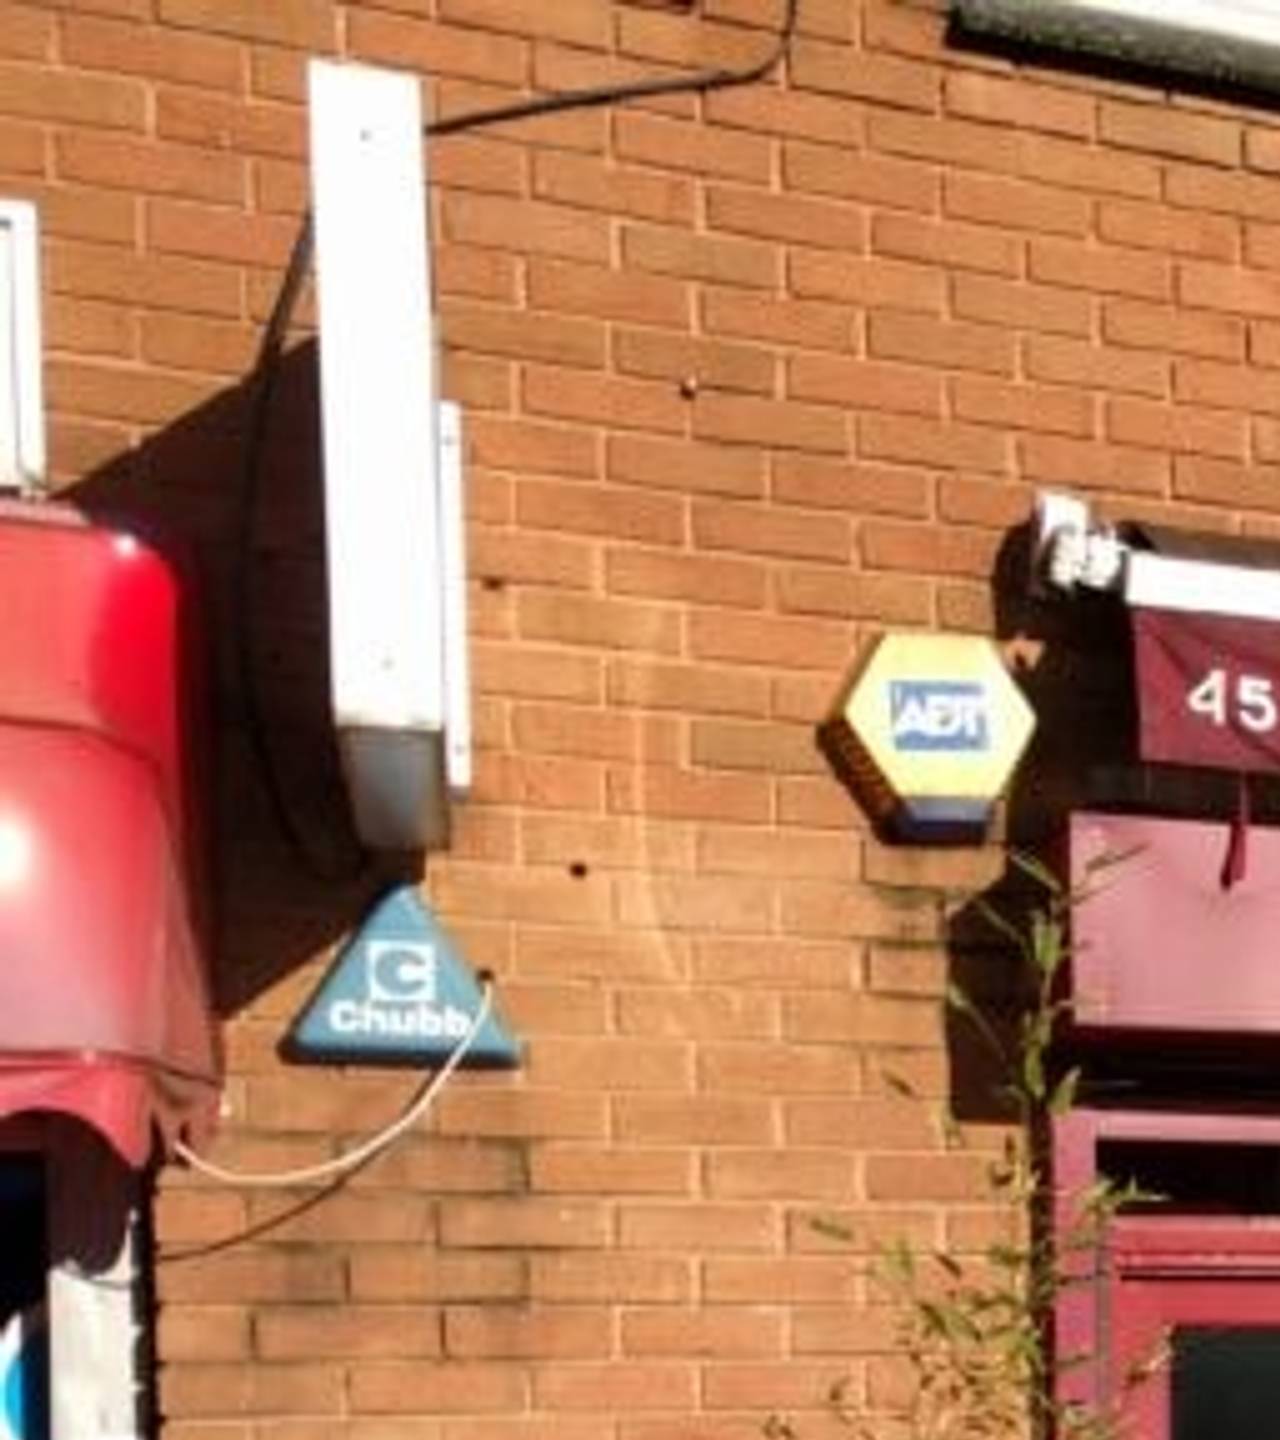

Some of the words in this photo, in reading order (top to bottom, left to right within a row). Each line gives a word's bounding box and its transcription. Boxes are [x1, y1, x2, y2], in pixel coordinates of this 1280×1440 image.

[895, 693, 987, 737] ADT
[1186, 668, 1279, 733] 45
[329, 1001, 474, 1036] Chubb
